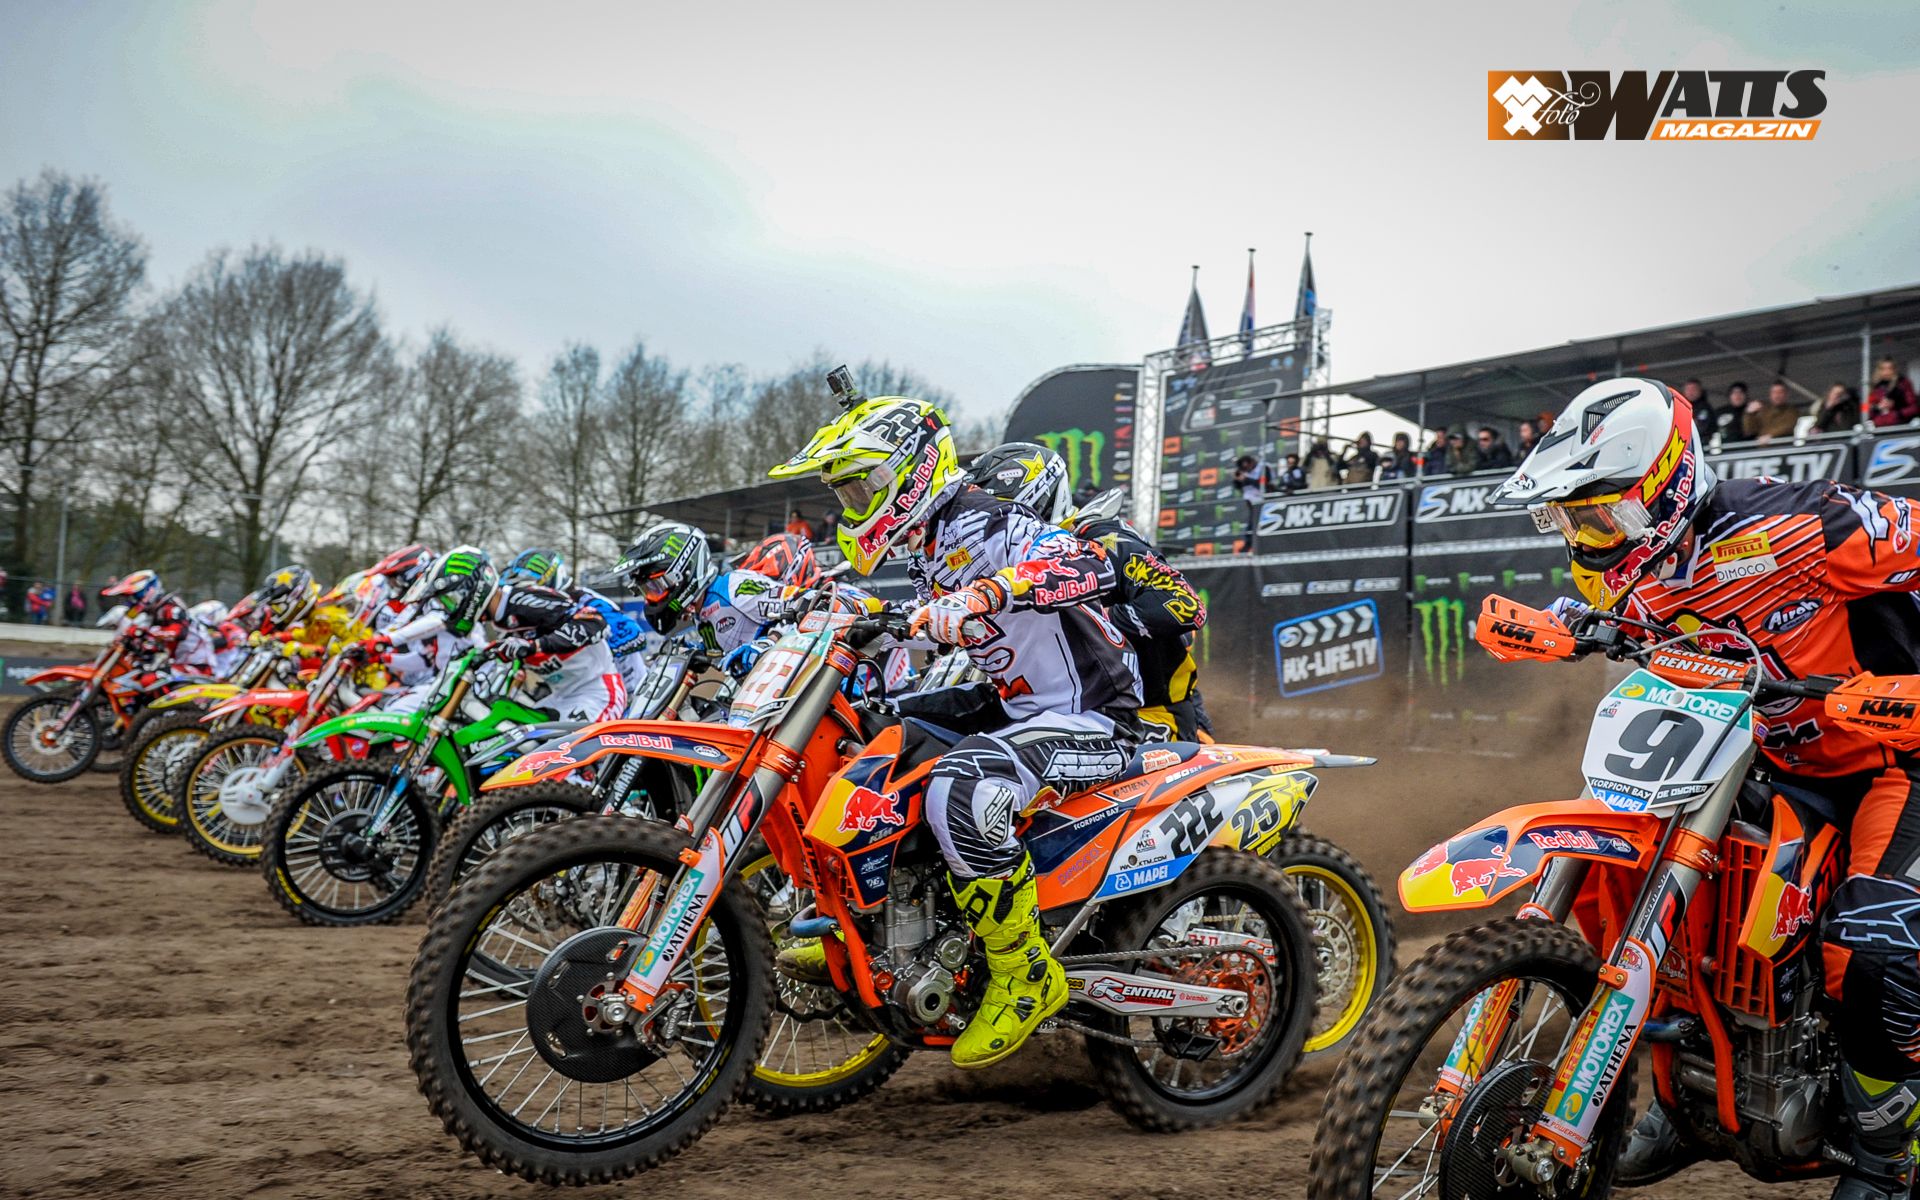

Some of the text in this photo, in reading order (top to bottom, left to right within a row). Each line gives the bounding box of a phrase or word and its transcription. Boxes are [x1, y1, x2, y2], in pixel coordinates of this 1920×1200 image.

[1717, 537, 1764, 558] PIRELLI
[1717, 562, 1766, 581] DIMOCO
[1768, 600, 1819, 630] Airoh
[1490, 621, 1536, 643] KTM
[1653, 654, 1740, 681] RENTHAL
[1859, 698, 1916, 719] KTM
[1604, 708, 1705, 783] 9
[613, 757, 642, 805] AMAHA
[1120, 779, 1149, 793] ATHENA
[1590, 777, 1652, 800] SCORPION BAY
[1656, 789, 1669, 799] DE
[1607, 794, 1643, 811] MAPEI
[1074, 806, 1120, 831] SCORPION BAY
[1159, 791, 1224, 859] 222
[1231, 791, 1282, 852] 25
[1058, 846, 1100, 883] DIMOCO
[1133, 865, 1168, 886] MAPEI
[652, 874, 701, 951] MOTOREX
[672, 893, 708, 952] ATHENA
[1088, 977, 1176, 1003] RENTHAL
[1186, 994, 1209, 1002] brembo
[1553, 1010, 1599, 1092] PIRELLI
[1572, 998, 1630, 1094] MOTOREX
[1598, 1024, 1637, 1092] ATHENA
